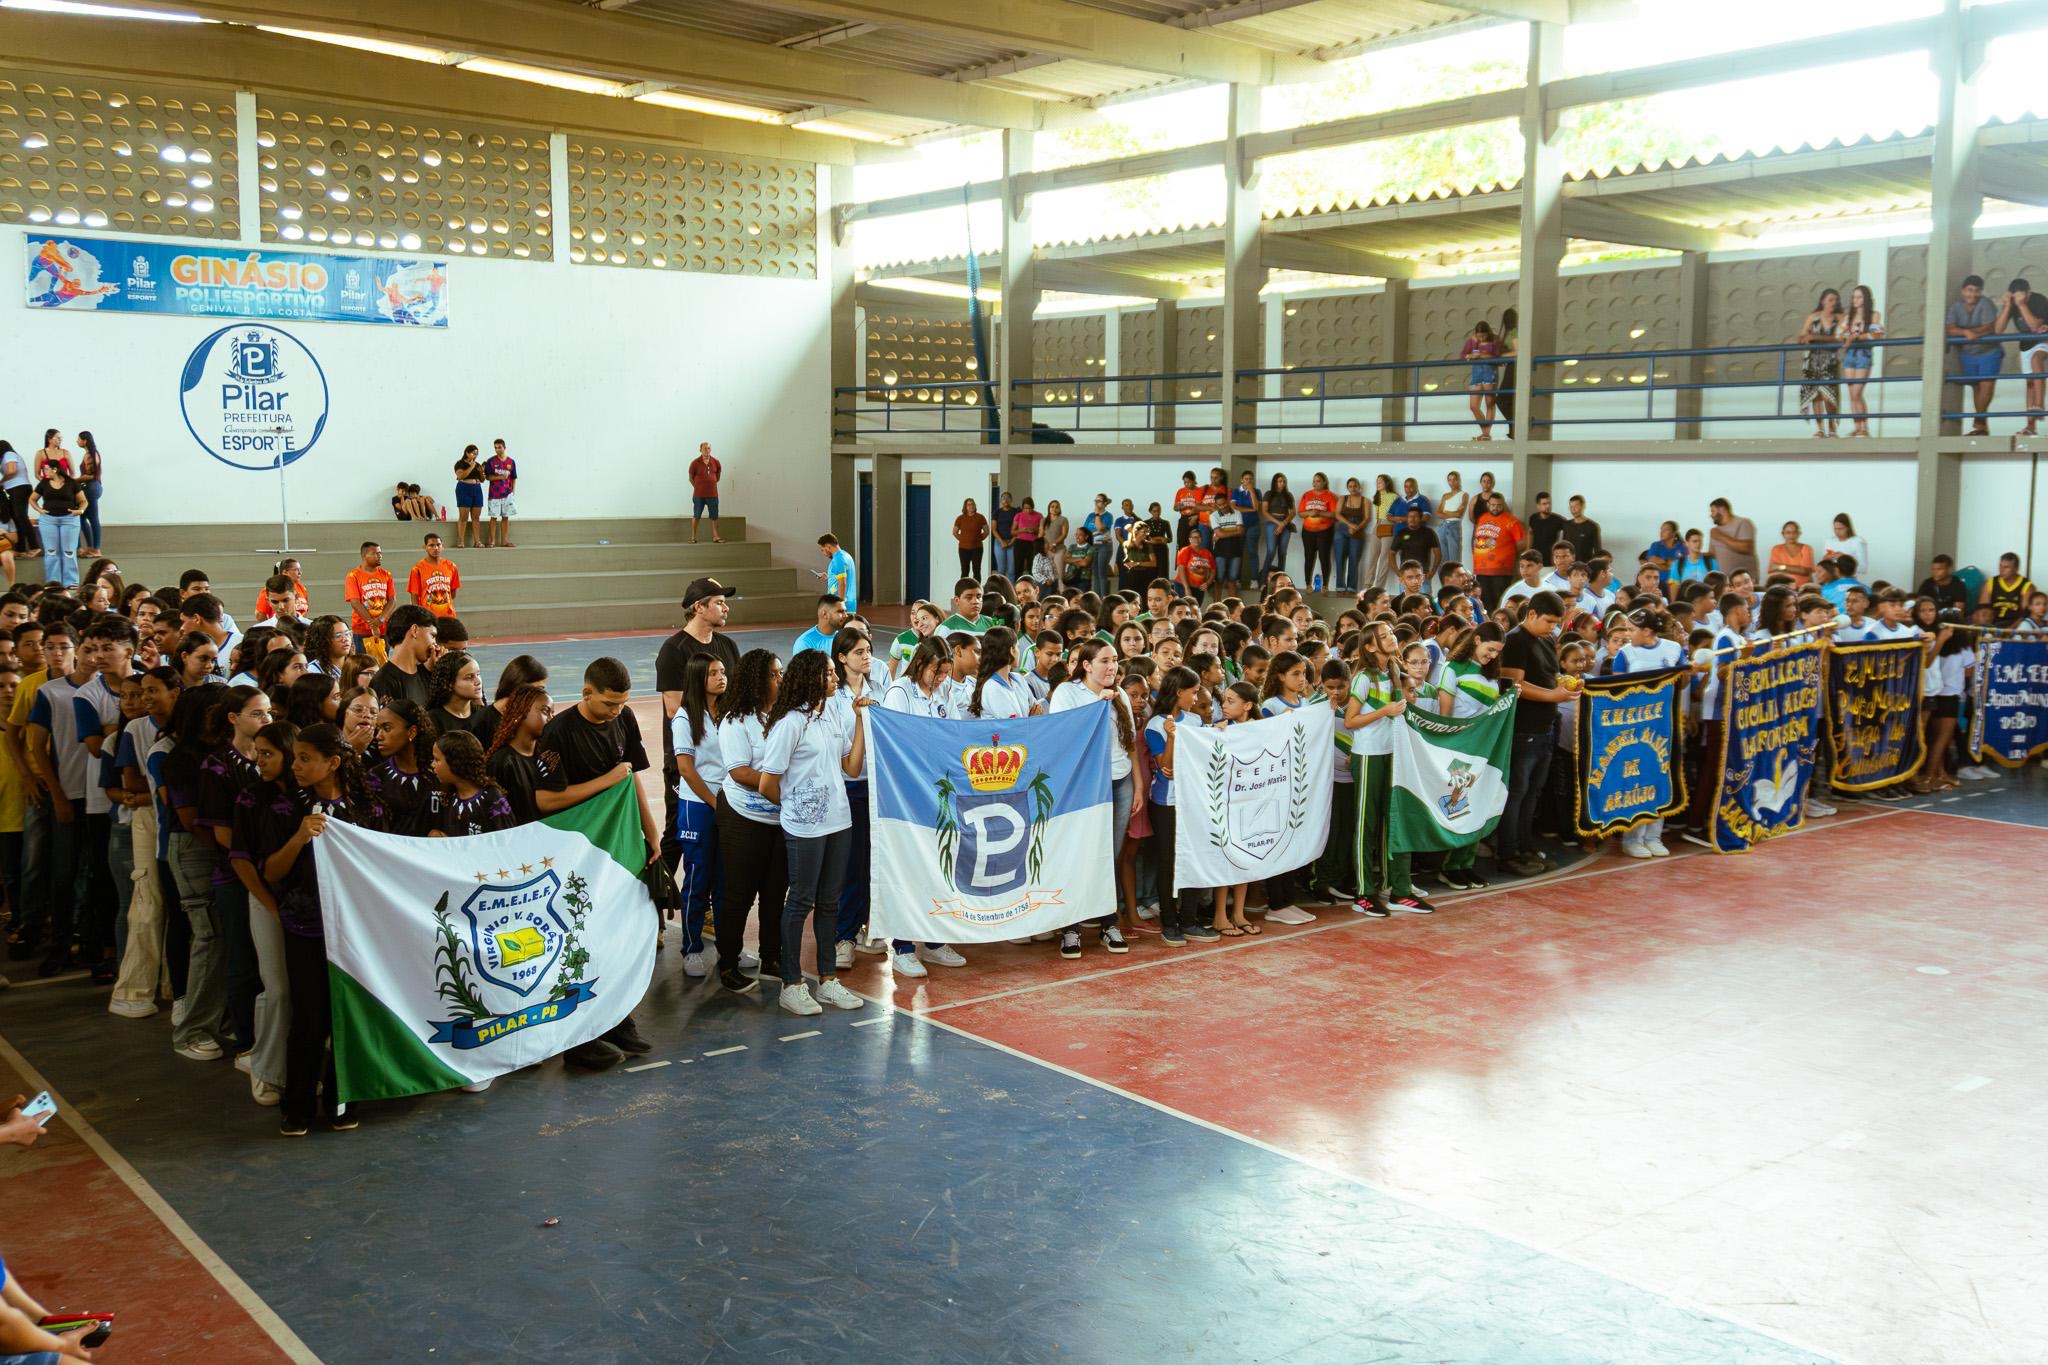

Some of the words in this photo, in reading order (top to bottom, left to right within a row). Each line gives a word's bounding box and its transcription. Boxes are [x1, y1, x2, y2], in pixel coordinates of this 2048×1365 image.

[171, 253, 328, 293] GINÁSIO
[127, 277, 157, 289] Pilar
[175, 287, 325, 307] POLIESPORTIVO
[341, 289, 366, 300] Pilar
[190, 304, 237, 313] GENIVAL
[259, 307, 273, 315] DA
[278, 308, 312, 317] COSTA
[222, 384, 289, 411] Pilar
[223, 413, 292, 423] PREFEITURA
[1236, 770, 1242, 778] E
[1254, 767, 1260, 776] E
[1235, 784, 1246, 792] Dr.
[1267, 775, 1287, 786] Maria
[1603, 782, 1656, 812] ARAÚJO
[680, 831, 699, 840] ECIT
[478, 886, 551, 912] E.M.E.I.E.F.
[1005, 910, 1013, 918] de
[514, 911, 524, 920] V.
[526, 912, 557, 953] BORGES
[512, 965, 537, 981] 1968
[478, 1012, 528, 1042] PILAR
[541, 1004, 559, 1020] PB
